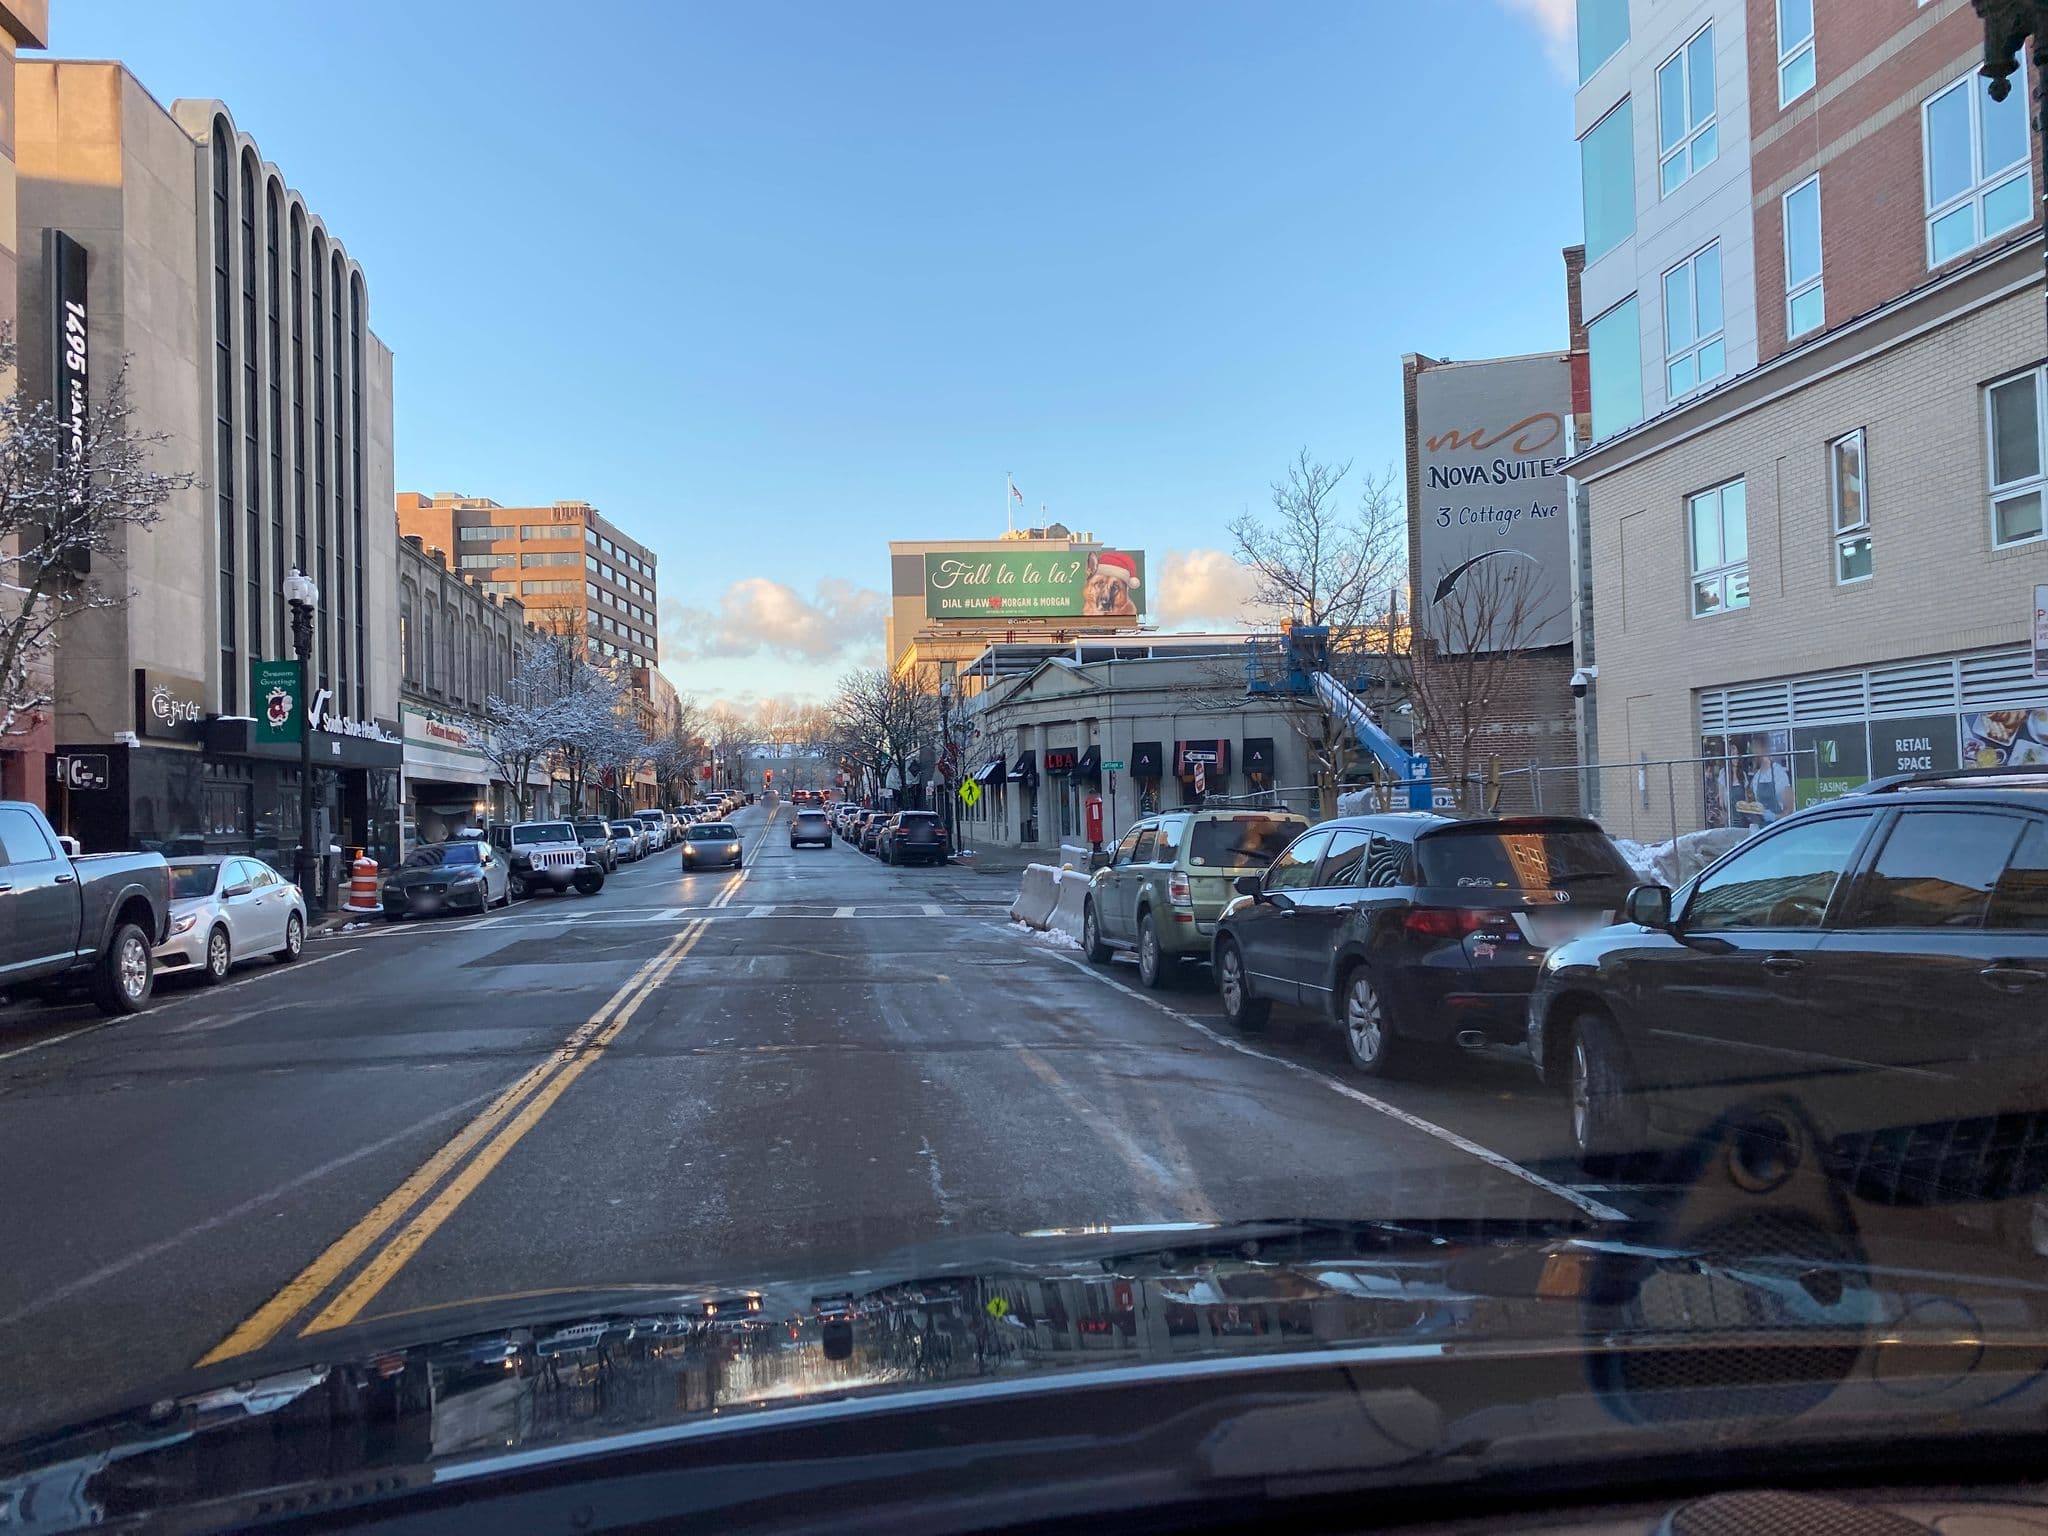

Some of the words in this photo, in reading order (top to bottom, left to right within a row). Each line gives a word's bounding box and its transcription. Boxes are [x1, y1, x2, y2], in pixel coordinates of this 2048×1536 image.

[65, 301, 86, 374] 1495
[1436, 507, 1451, 527] 3
[1459, 506, 1521, 536] Cottage
[1531, 501, 1558, 518] Ave
[931, 559, 992, 589] Fall
[997, 563, 1016, 585] la
[1023, 562, 1042, 584] la
[1048, 561, 1080, 584] la?
[942, 599, 962, 609] DIAL
[965, 598, 990, 608] #LAW
[1002, 598, 1031, 607] MORGAN
[1033, 598, 1039, 607] &
[1040, 597, 1070, 607] MORGAN
[185, 700, 201, 722] CAT
[1895, 737, 1932, 752] RETAIL
[1897, 756, 1932, 771] SPACE
[1816, 782, 1848, 793] EASING
